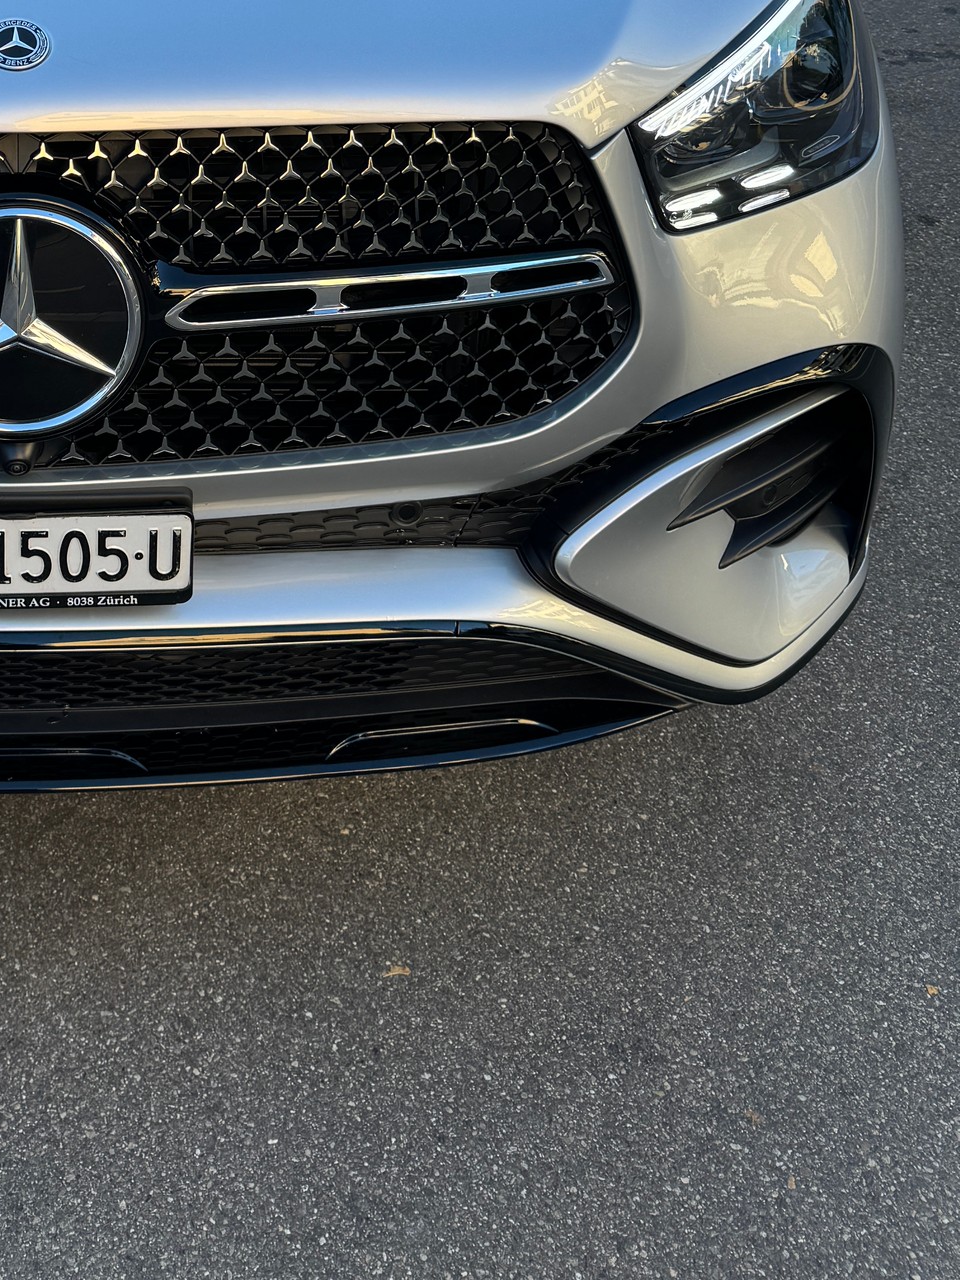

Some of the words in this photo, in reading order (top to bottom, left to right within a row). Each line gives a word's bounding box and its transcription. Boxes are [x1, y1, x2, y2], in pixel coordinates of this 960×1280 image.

[28, 597, 50, 608] AG
[67, 596, 94, 607] 8038
[97, 594, 138, 606] Zürich
